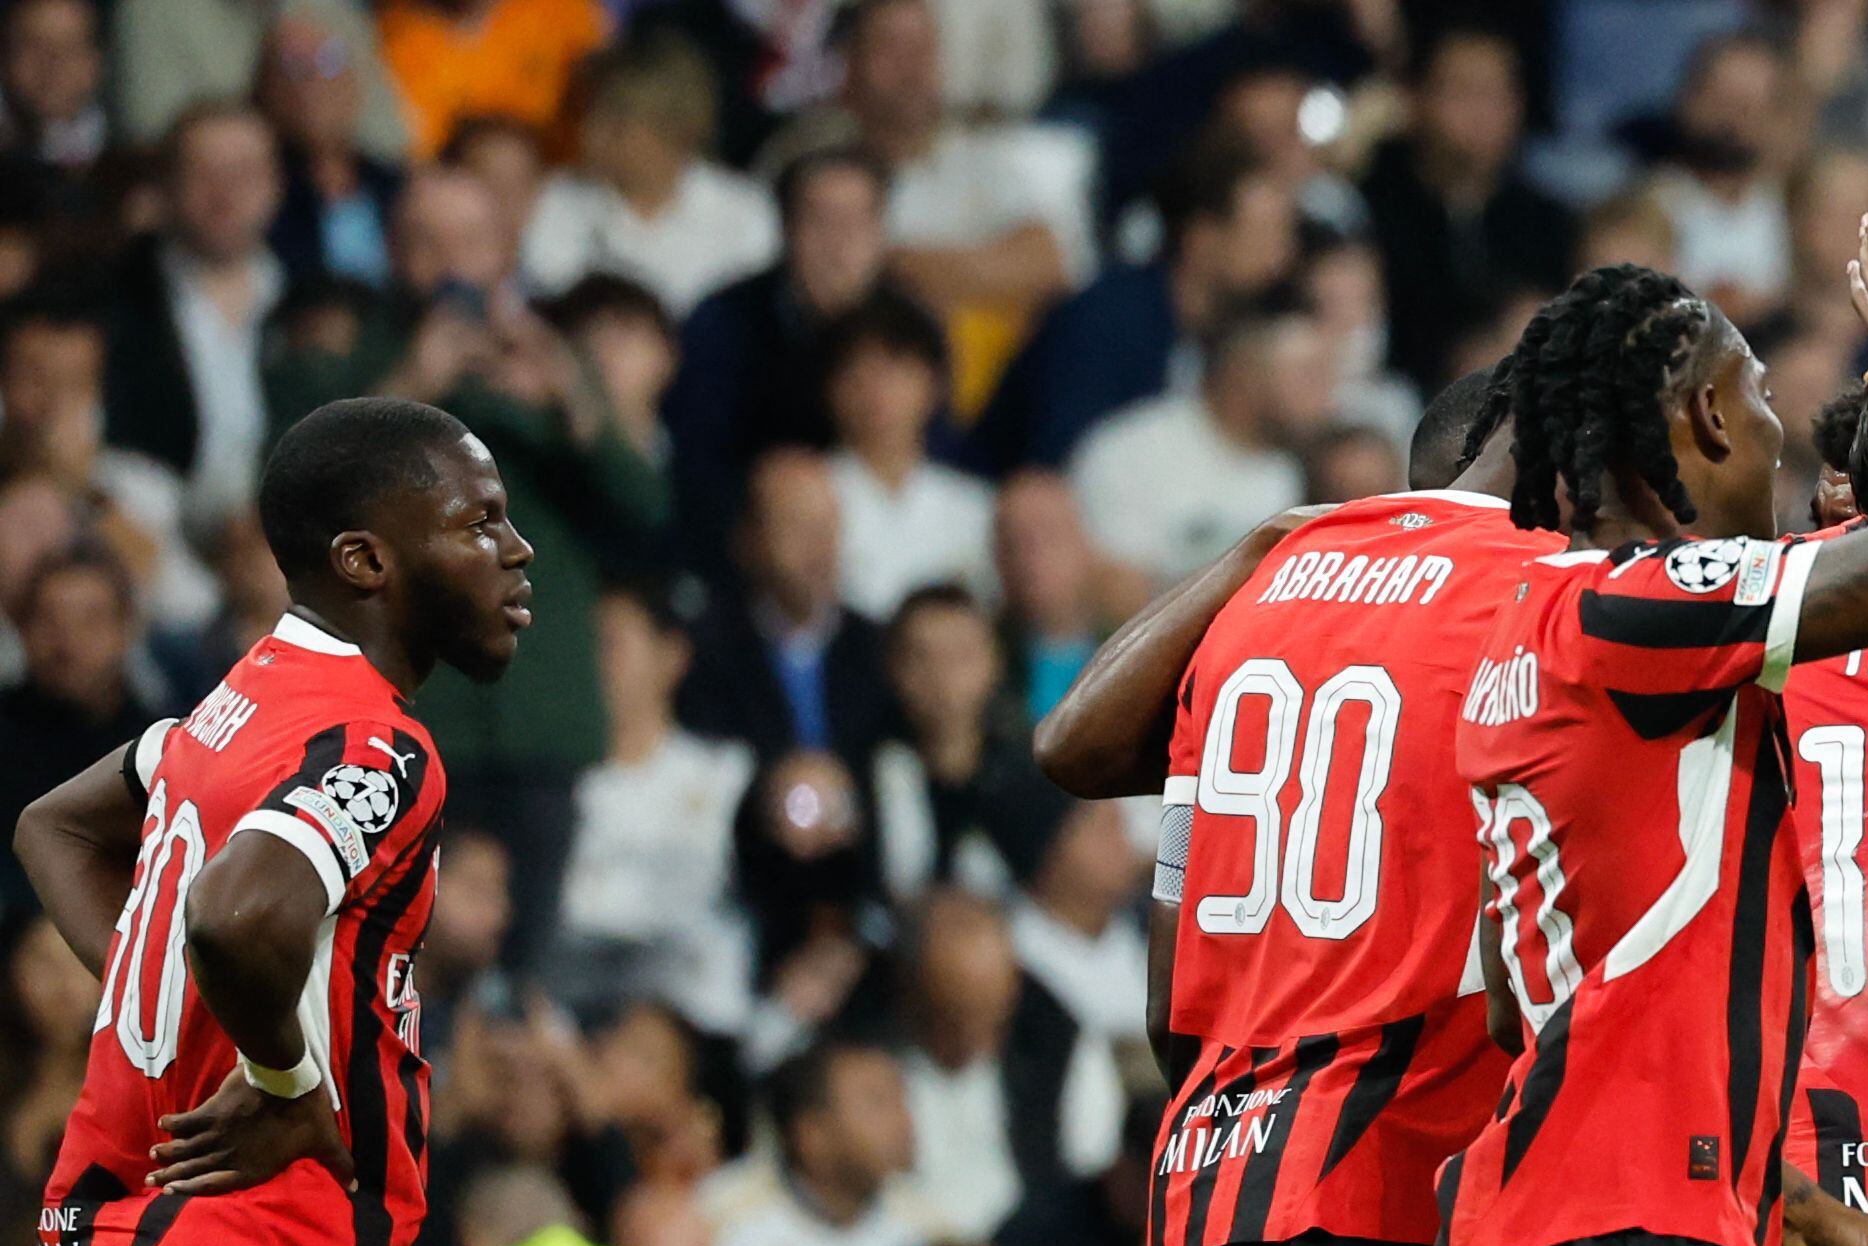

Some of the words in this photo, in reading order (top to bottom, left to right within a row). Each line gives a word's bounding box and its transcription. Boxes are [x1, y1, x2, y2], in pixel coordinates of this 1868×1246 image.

[1256, 551, 1454, 605] ABRAHAM
[1197, 658, 1402, 940] 90
[1158, 1113, 1277, 1176] MILAN
